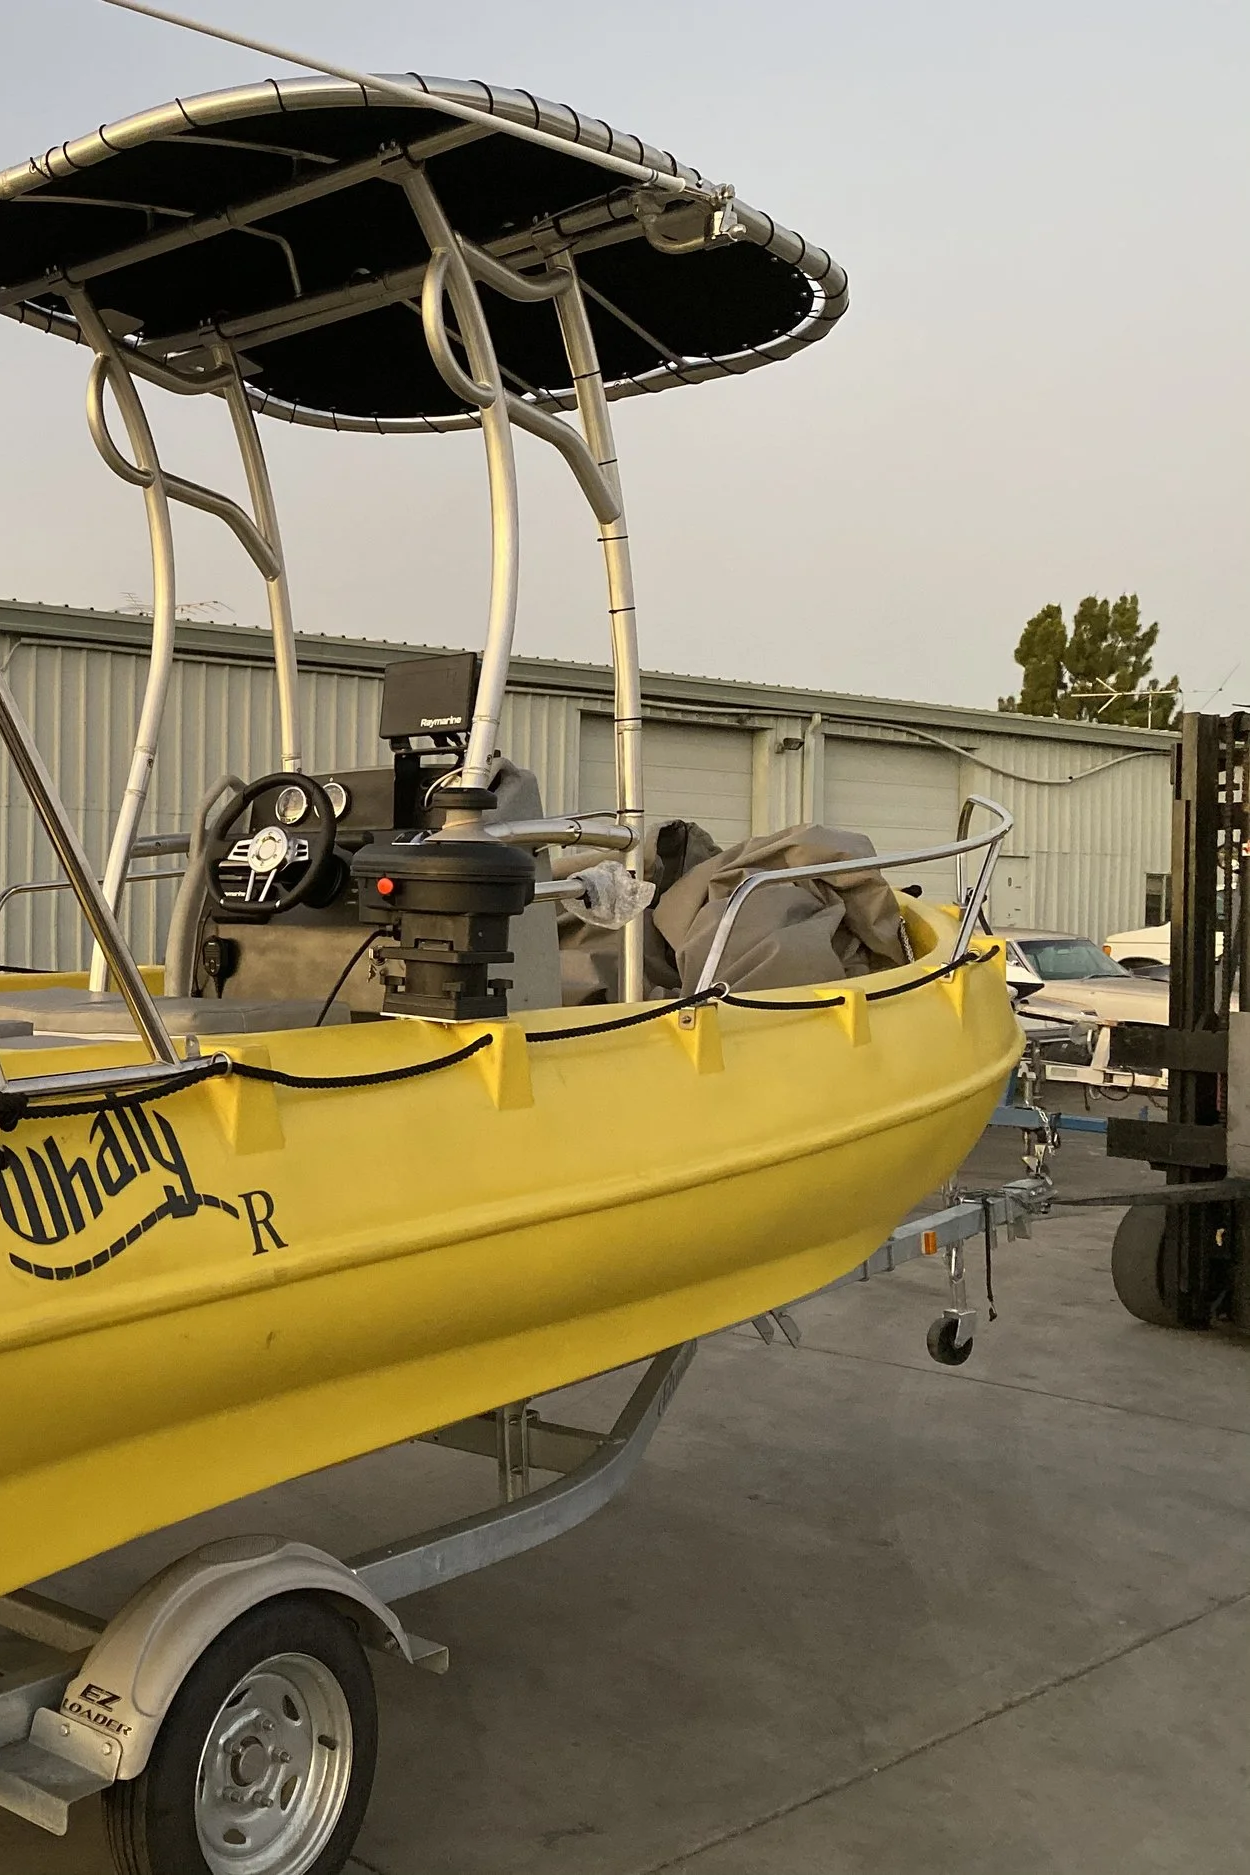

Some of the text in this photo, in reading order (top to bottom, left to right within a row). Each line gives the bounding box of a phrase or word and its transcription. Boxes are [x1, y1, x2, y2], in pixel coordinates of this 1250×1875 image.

[420, 715, 462, 729] Raymarine
[238, 1190, 289, 1257] R
[78, 1683, 123, 1712] EZ
[61, 1697, 133, 1736] LOADER
